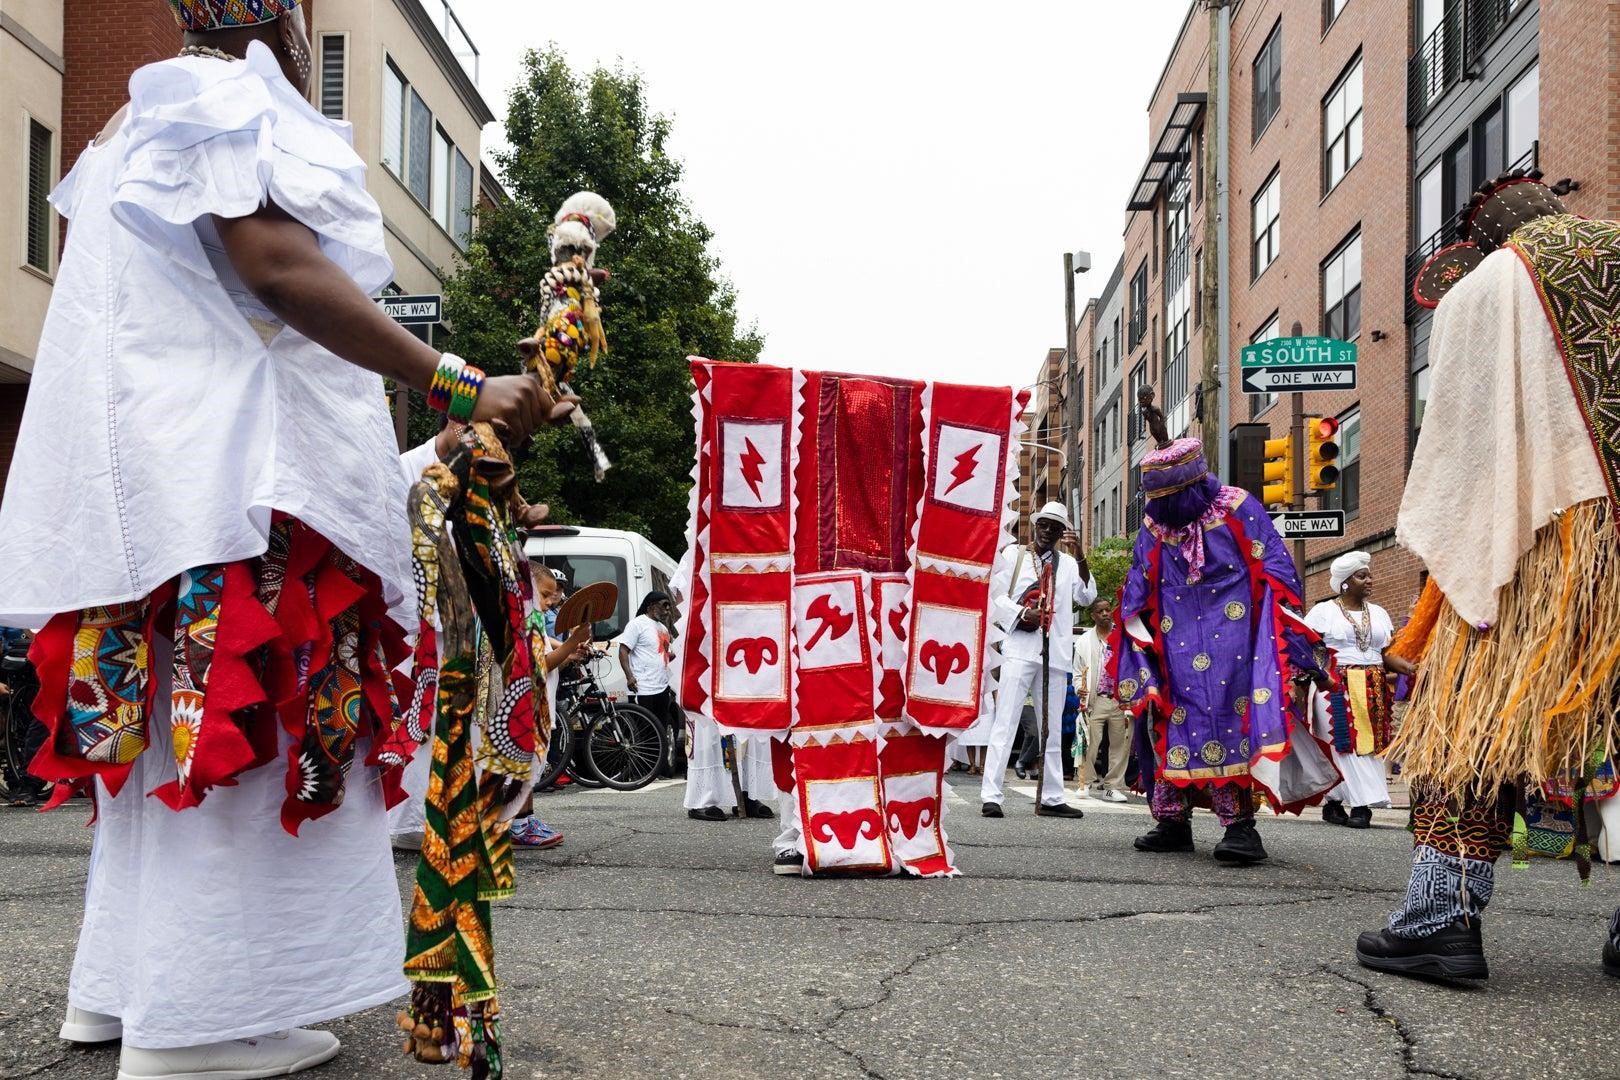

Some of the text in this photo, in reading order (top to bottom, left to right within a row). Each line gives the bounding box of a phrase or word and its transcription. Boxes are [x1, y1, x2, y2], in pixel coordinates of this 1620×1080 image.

[384, 303, 432, 316] ONE WAY
[1295, 339, 1302, 347] W
[1260, 346, 1353, 364] SOUTH ST
[1271, 372, 1343, 384] ONE WAY
[1284, 519, 1335, 531] ONE WAY
